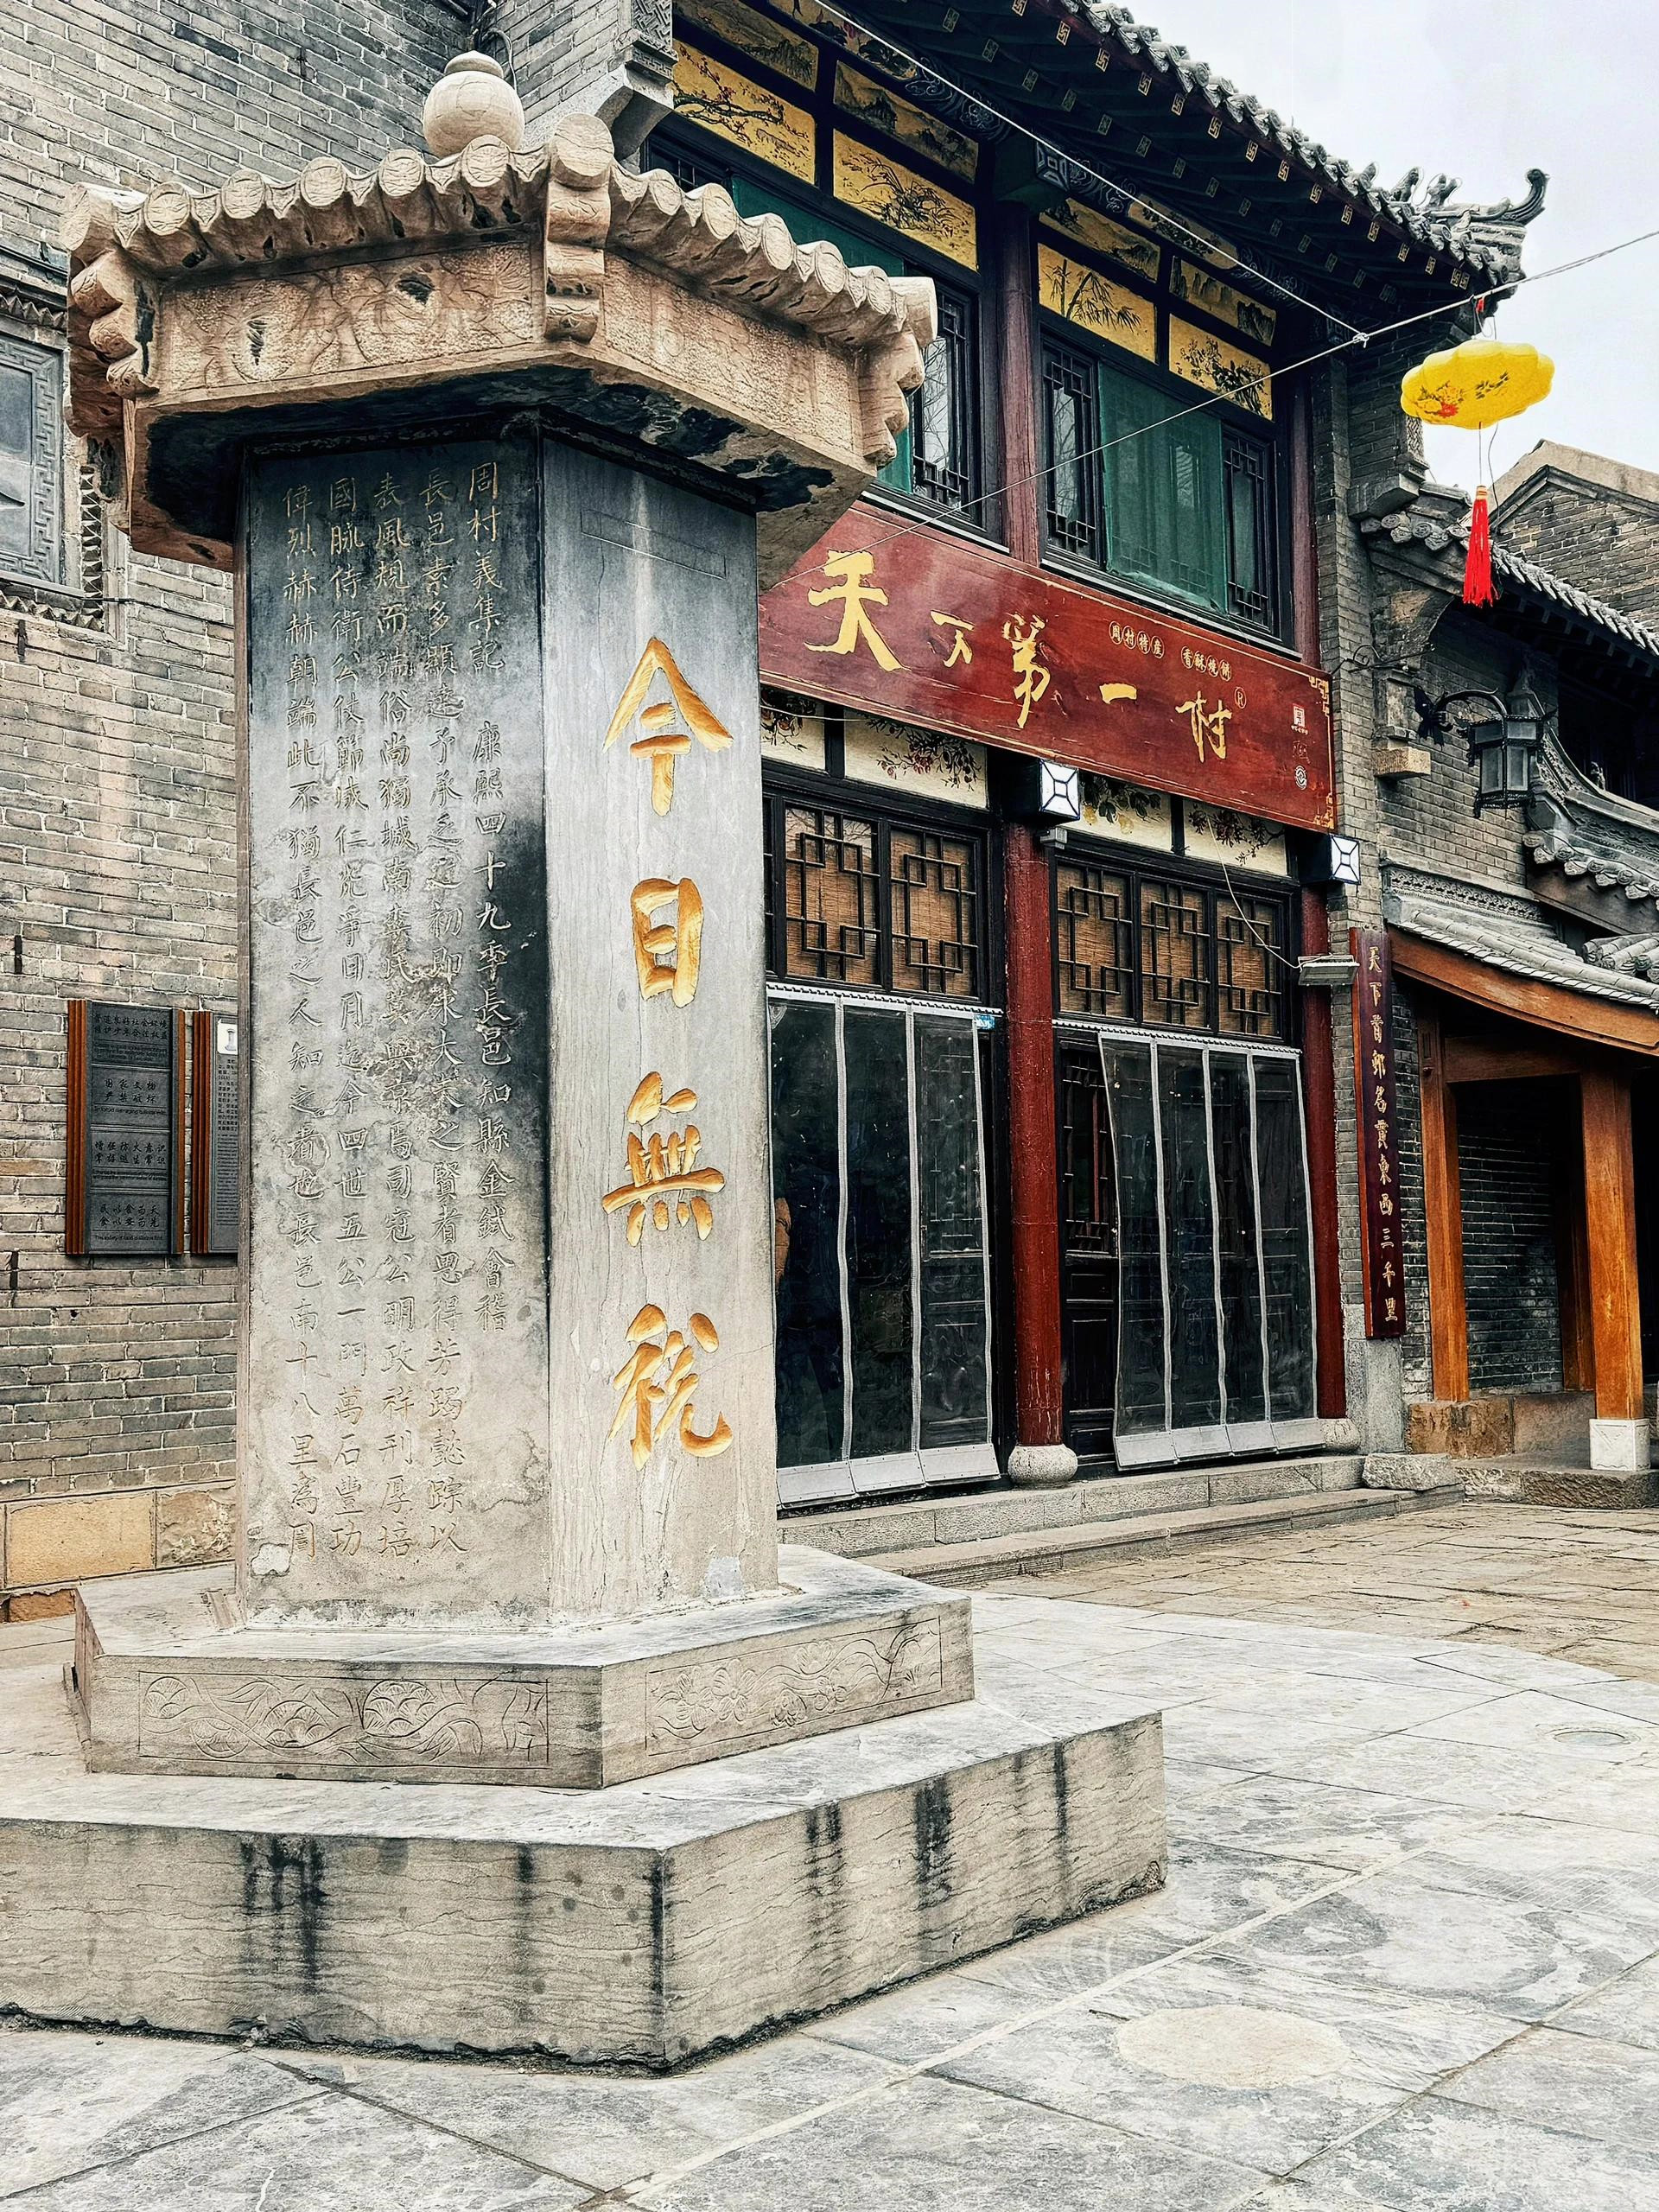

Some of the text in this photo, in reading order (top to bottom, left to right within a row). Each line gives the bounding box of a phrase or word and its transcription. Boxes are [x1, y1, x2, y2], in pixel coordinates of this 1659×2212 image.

[804, 549, 1232, 763] 天下第一村
